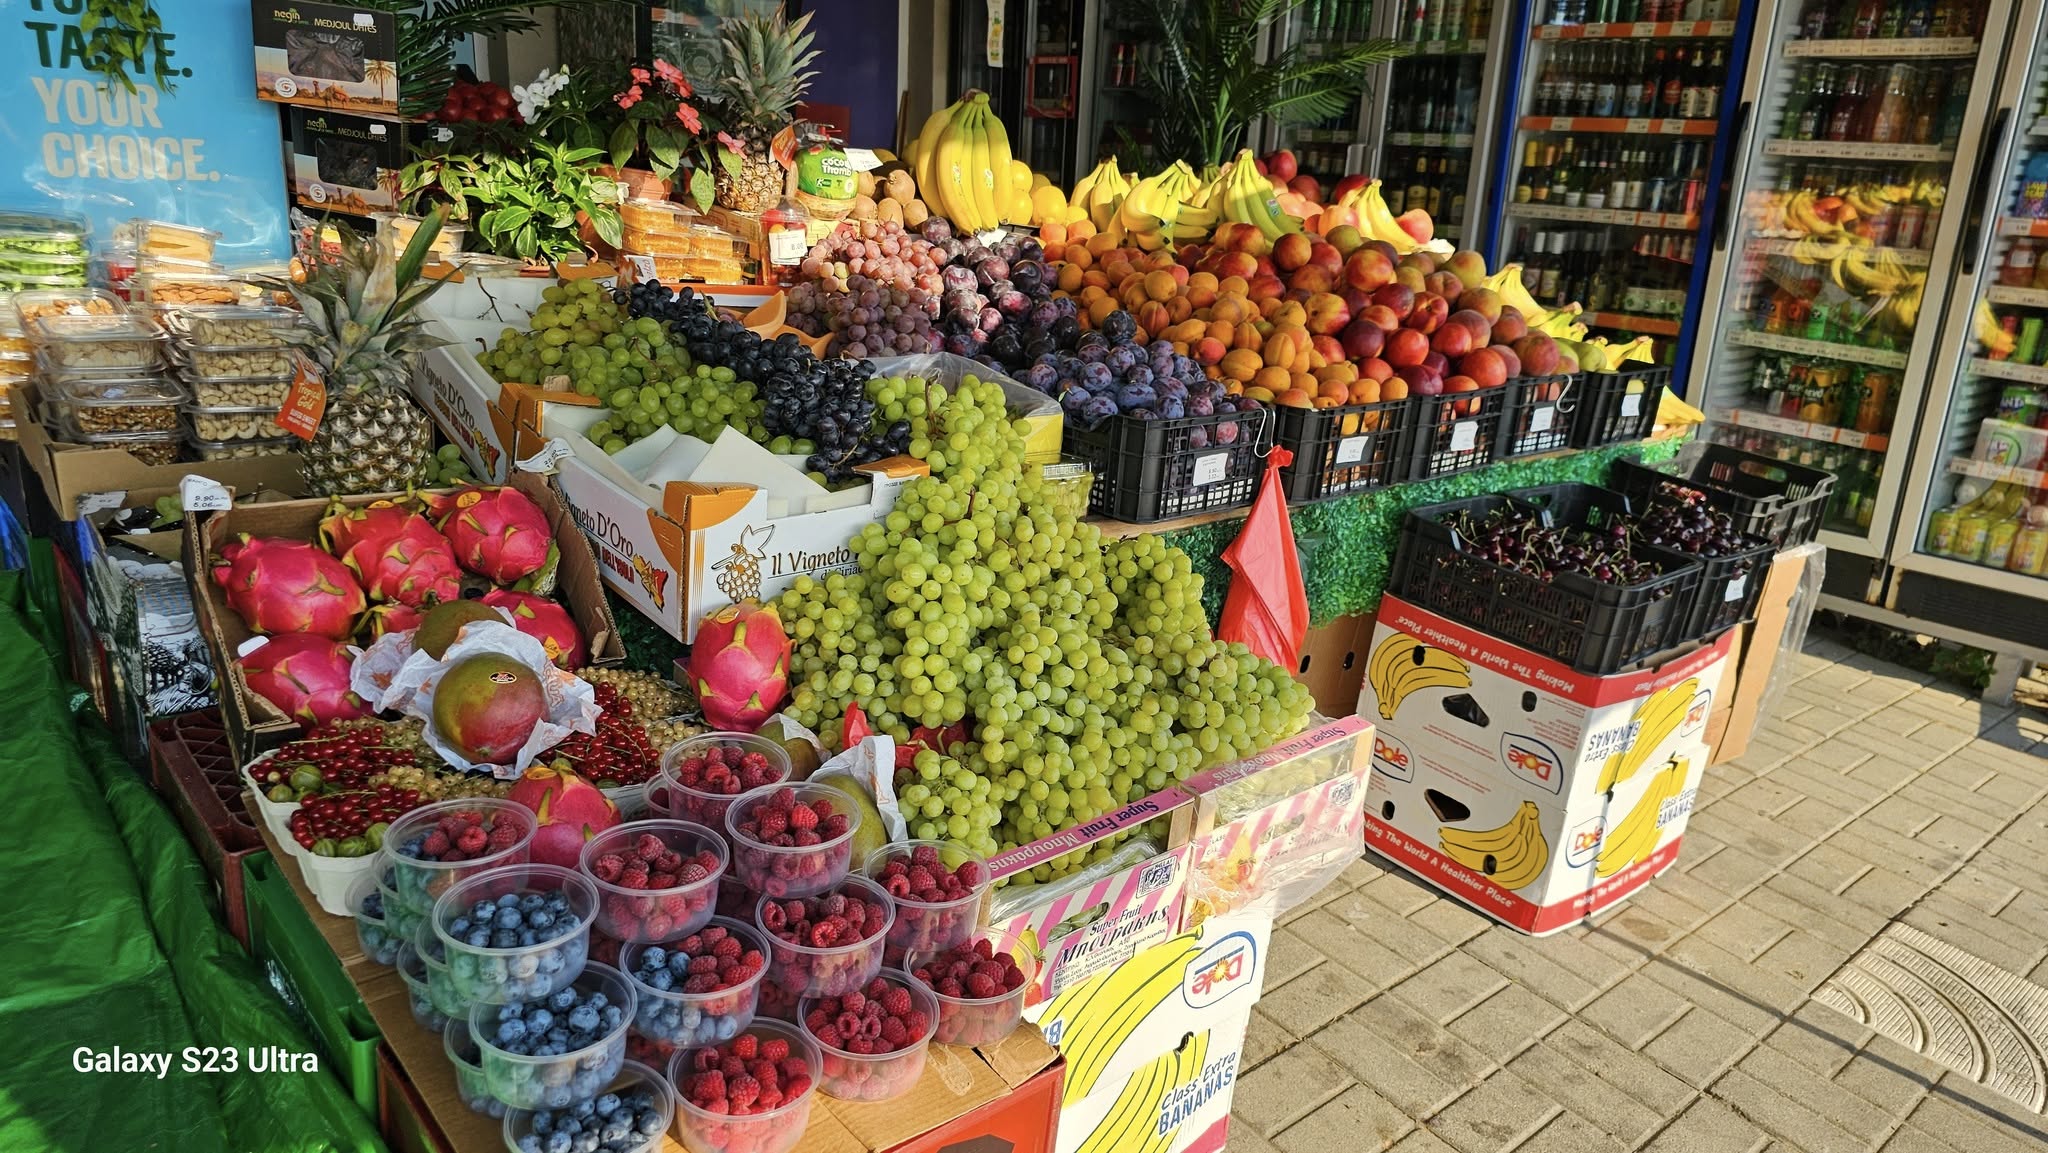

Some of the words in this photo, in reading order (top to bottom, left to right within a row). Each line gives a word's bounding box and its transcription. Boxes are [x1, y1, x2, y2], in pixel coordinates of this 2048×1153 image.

[314, 18, 351, 31] MEDJOUL
[31, 77, 163, 129] YOUR
[338, 127, 366, 140] MEDJOUL
[42, 132, 220, 182] CHOICE.
[448, 380, 475, 430] D'Oro
[597, 511, 634, 557] D'Oro
[788, 545, 850, 577] Vigneto
[1424, 628, 1467, 652] Healthier
[1470, 646, 1477, 656] A
[1480, 651, 1509, 670] World
[1512, 662, 1531, 679] The
[1535, 669, 1575, 693] Making
[1313, 726, 1347, 744] Super
[1588, 720, 1641, 751] BANANAS
[1375, 737, 1409, 767] Dole
[1508, 749, 1553, 782] Dole
[1119, 800, 1160, 819] Super
[1079, 817, 1120, 838] Fruit
[1574, 826, 1603, 852] Dole
[1364, 820, 1383, 838] king
[1386, 831, 1402, 846] The
[1403, 841, 1430, 861] World
[1430, 858, 1438, 867] A
[1440, 862, 1484, 892] Healthier
[1485, 886, 1512, 908] Place
[1089, 917, 1118, 937] Super
[1120, 903, 1143, 922] Fruit
[1191, 953, 1244, 996] Dole
[1161, 1077, 1198, 1111] Class
[1202, 1051, 1237, 1083] Extra
[1157, 1064, 1235, 1136] BANANAS
